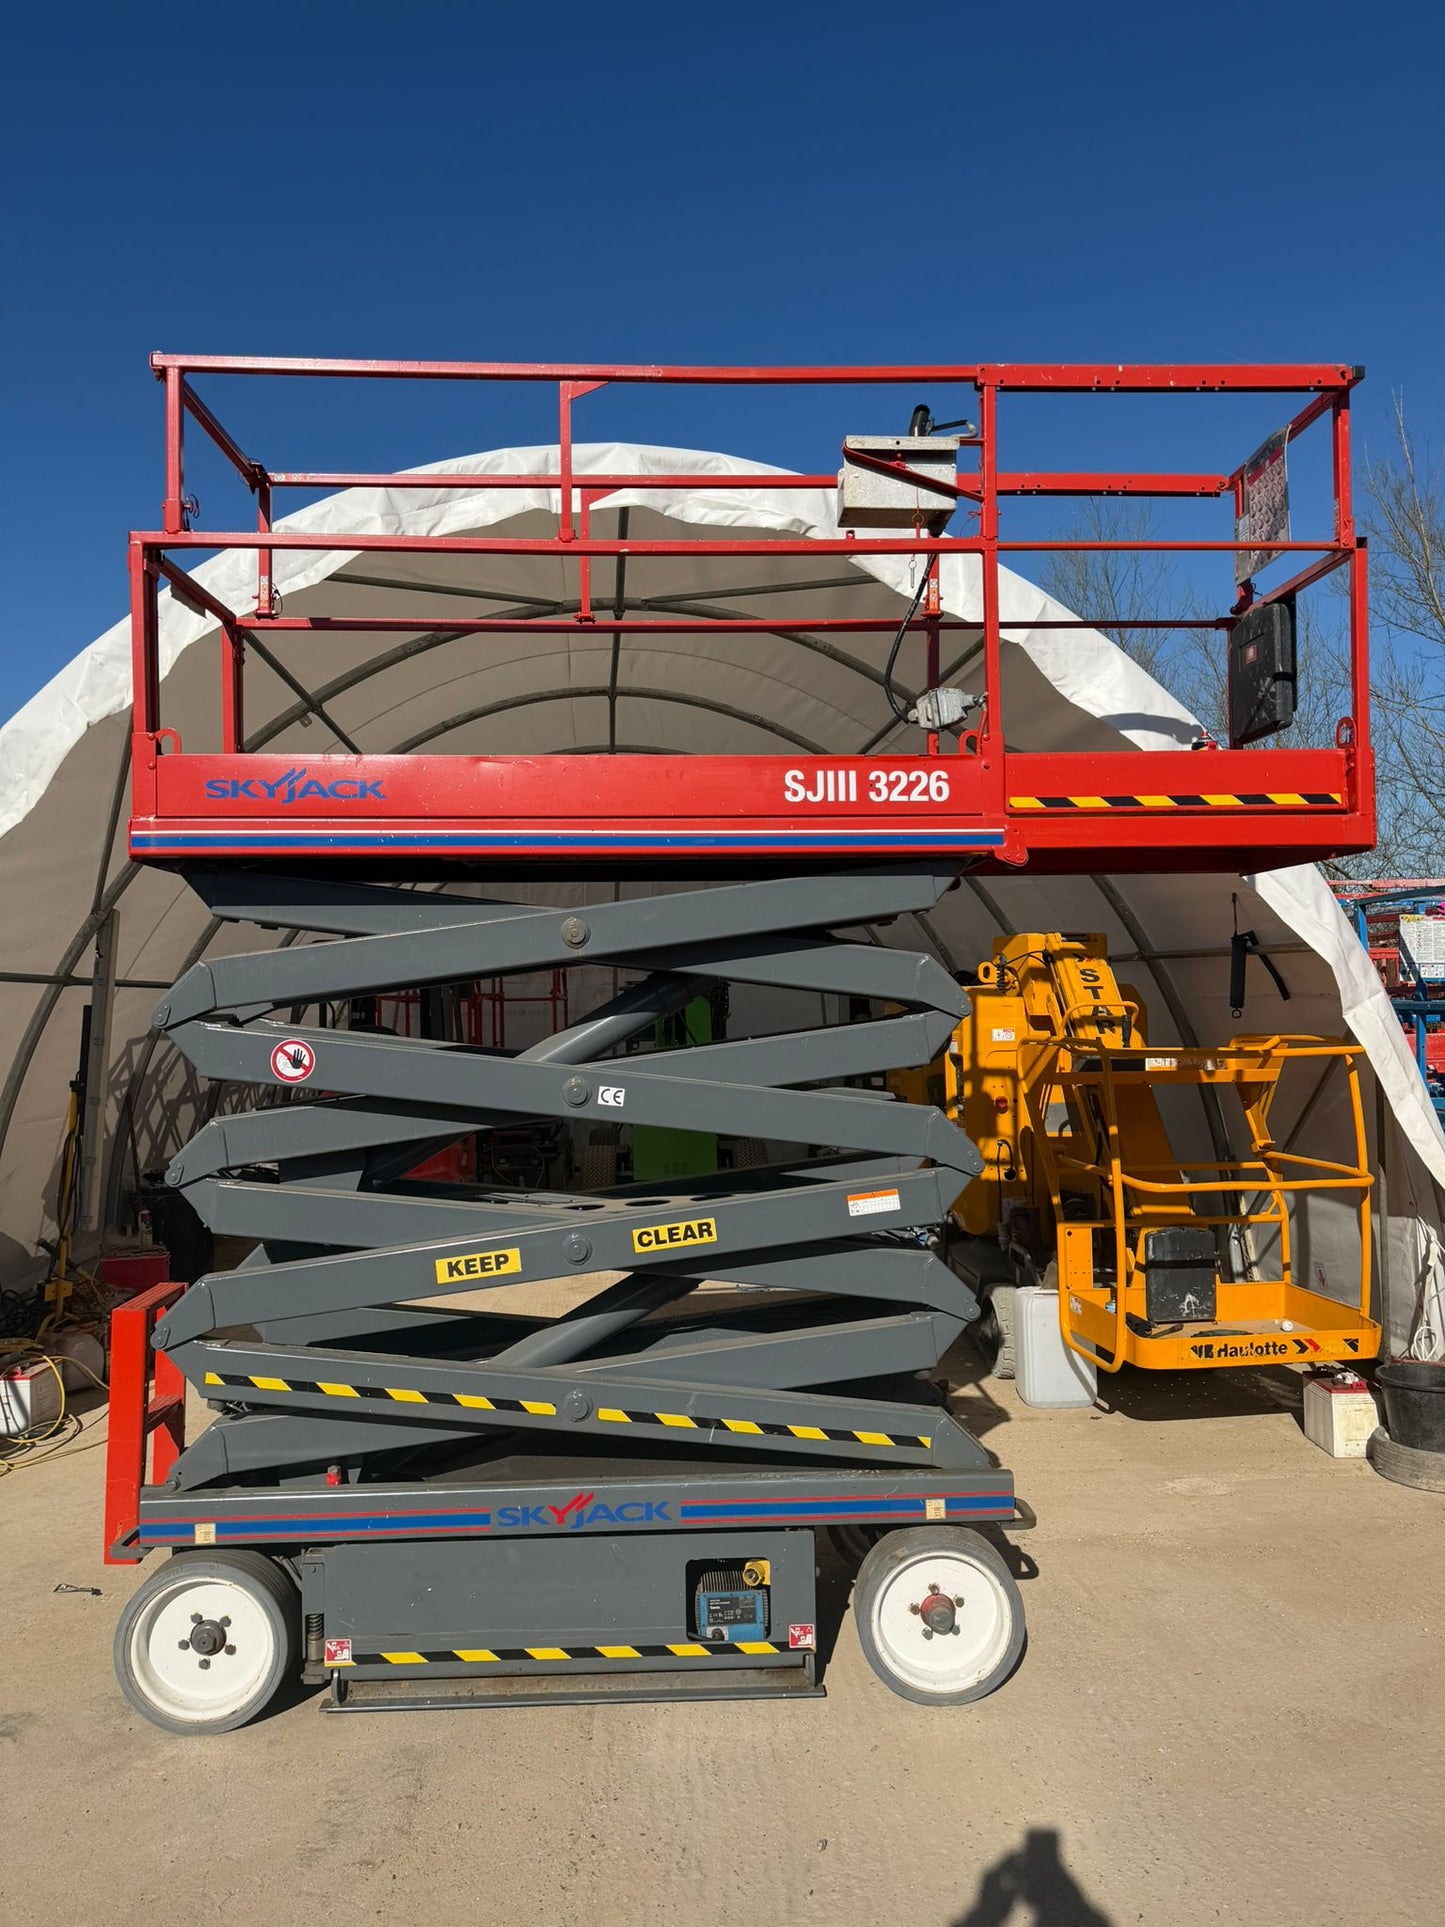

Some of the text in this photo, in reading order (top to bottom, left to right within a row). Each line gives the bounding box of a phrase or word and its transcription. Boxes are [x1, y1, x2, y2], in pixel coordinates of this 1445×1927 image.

[784, 769, 950, 803] SJIII 3226
[1079, 969, 1117, 1034] STAR
[600, 1088, 623, 1105] CE
[447, 1221, 714, 1278] KEEP CLEAR
